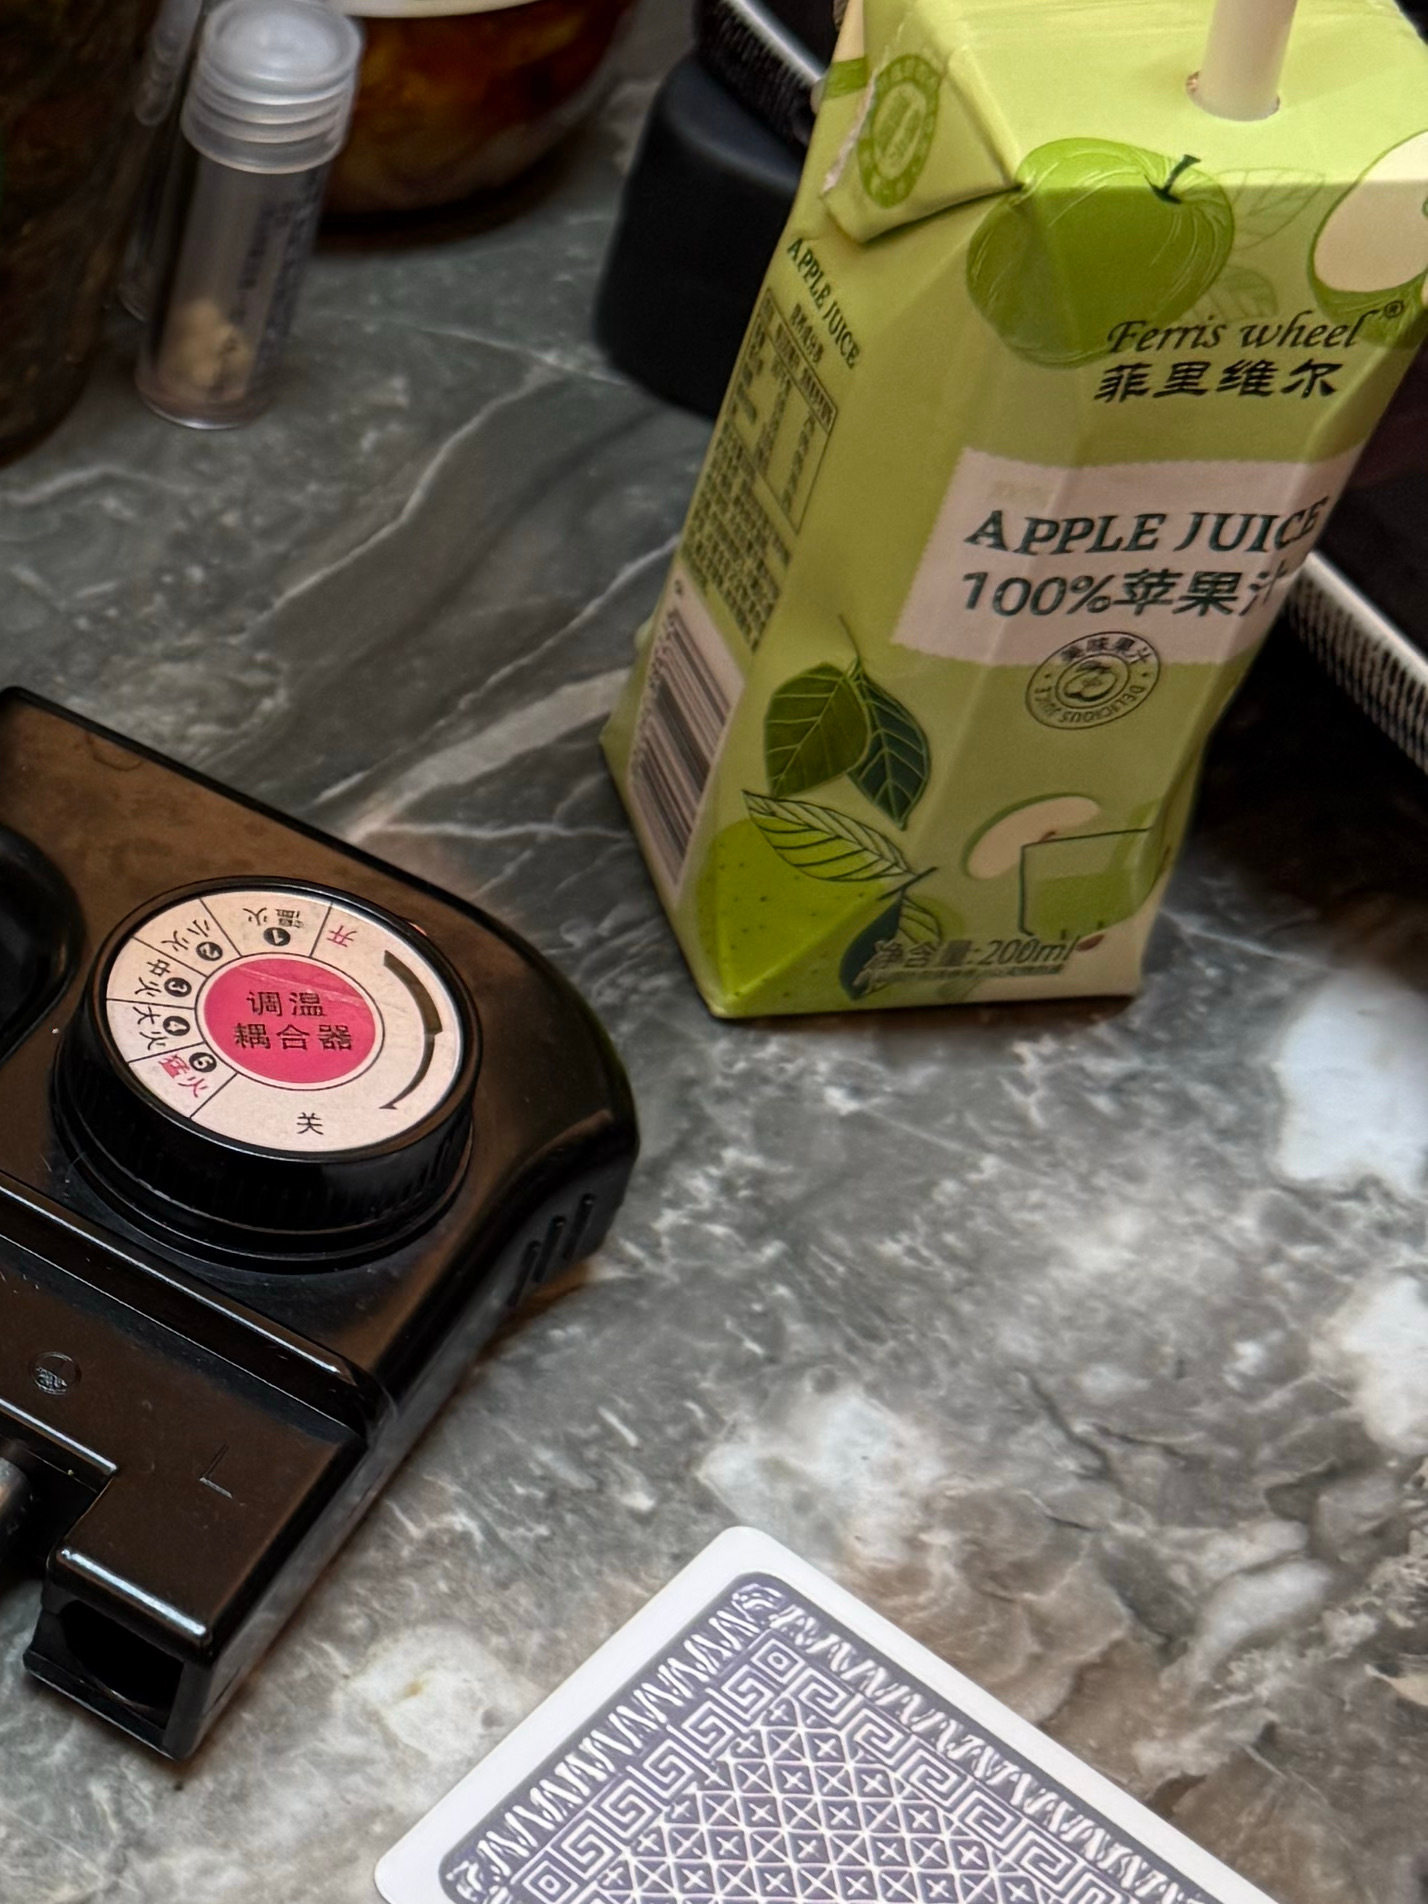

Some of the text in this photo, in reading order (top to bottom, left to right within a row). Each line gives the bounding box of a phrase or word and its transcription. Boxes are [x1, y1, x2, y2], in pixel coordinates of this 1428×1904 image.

[787, 237, 861, 371] APPLE JUICE
[1106, 308, 1380, 354] Ferris wheel
[1094, 359, 1345, 404] 菲里维尔
[963, 496, 1332, 556] APPLE JUICE
[160, 917, 211, 957] 小火
[325, 923, 357, 949] 开
[133, 957, 173, 998] 中火
[246, 990, 328, 1018] 调温
[133, 1005, 168, 1051] 大火
[232, 1022, 354, 1052] 耦合器
[296, 1110, 325, 1137] 关
